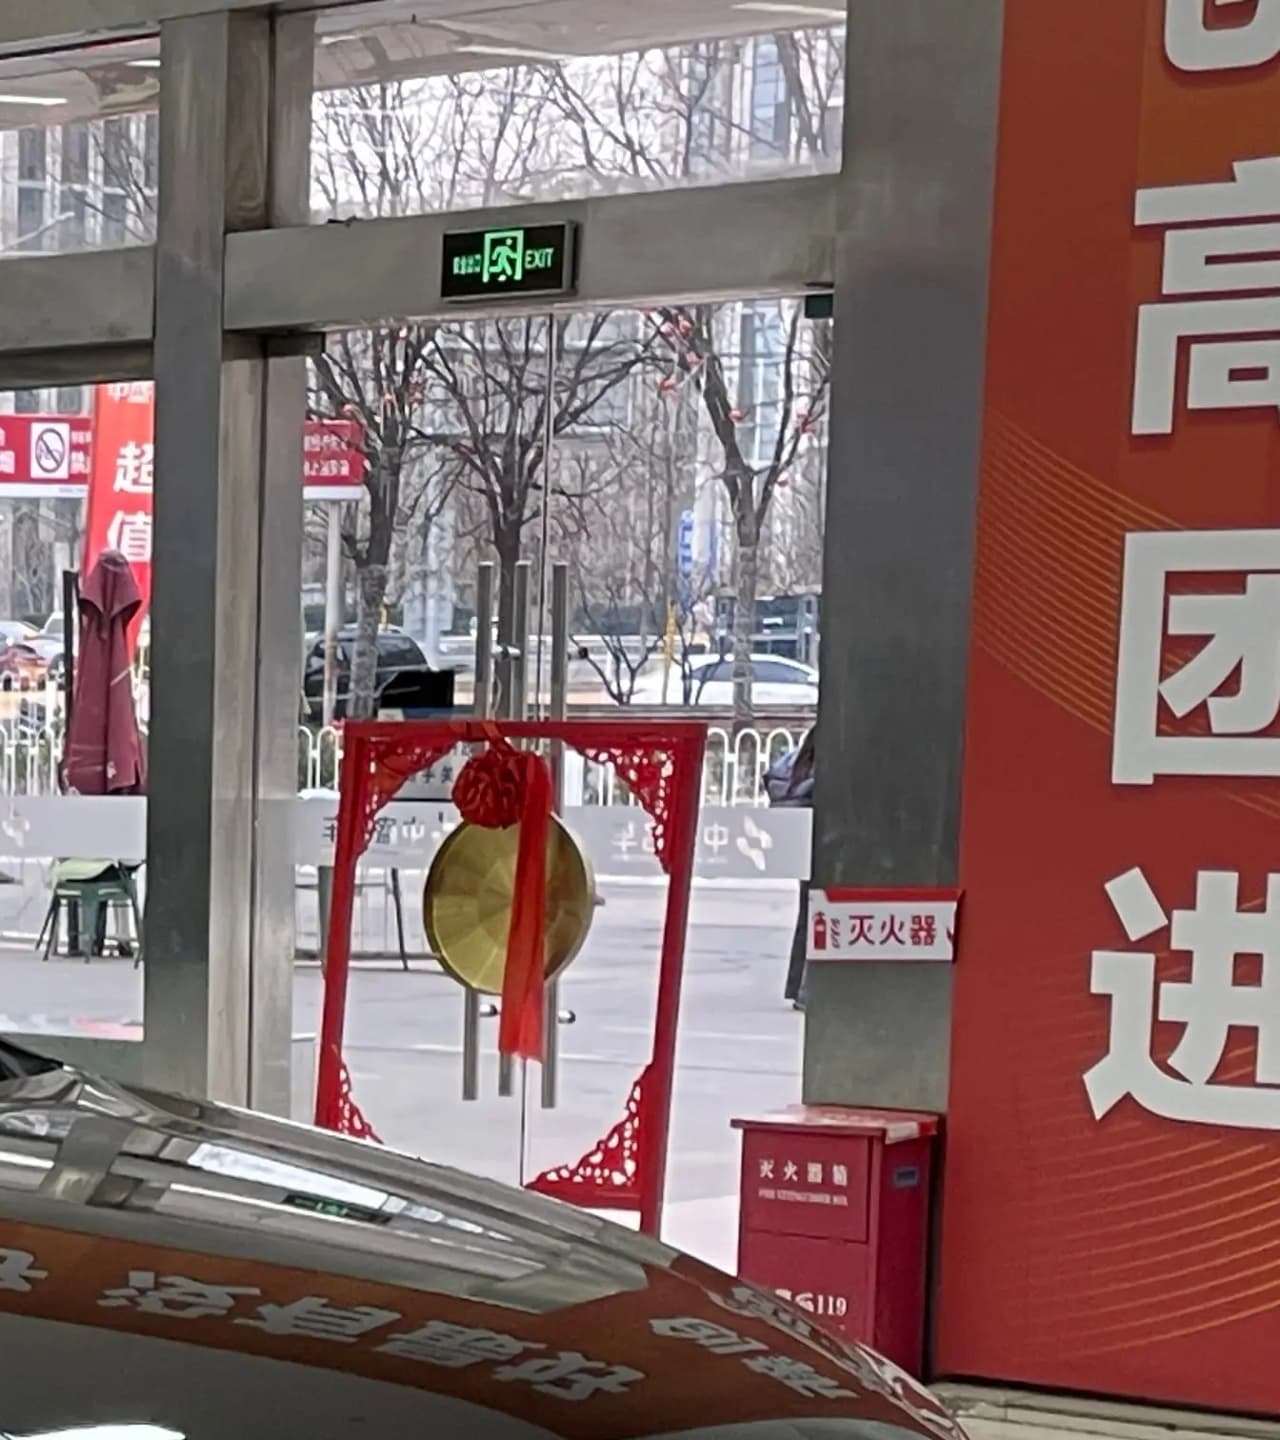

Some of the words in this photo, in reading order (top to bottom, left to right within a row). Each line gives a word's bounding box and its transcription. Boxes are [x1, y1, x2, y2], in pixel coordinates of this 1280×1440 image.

[524, 247, 554, 269] EXIT
[847, 914, 937, 947] 灭火器
